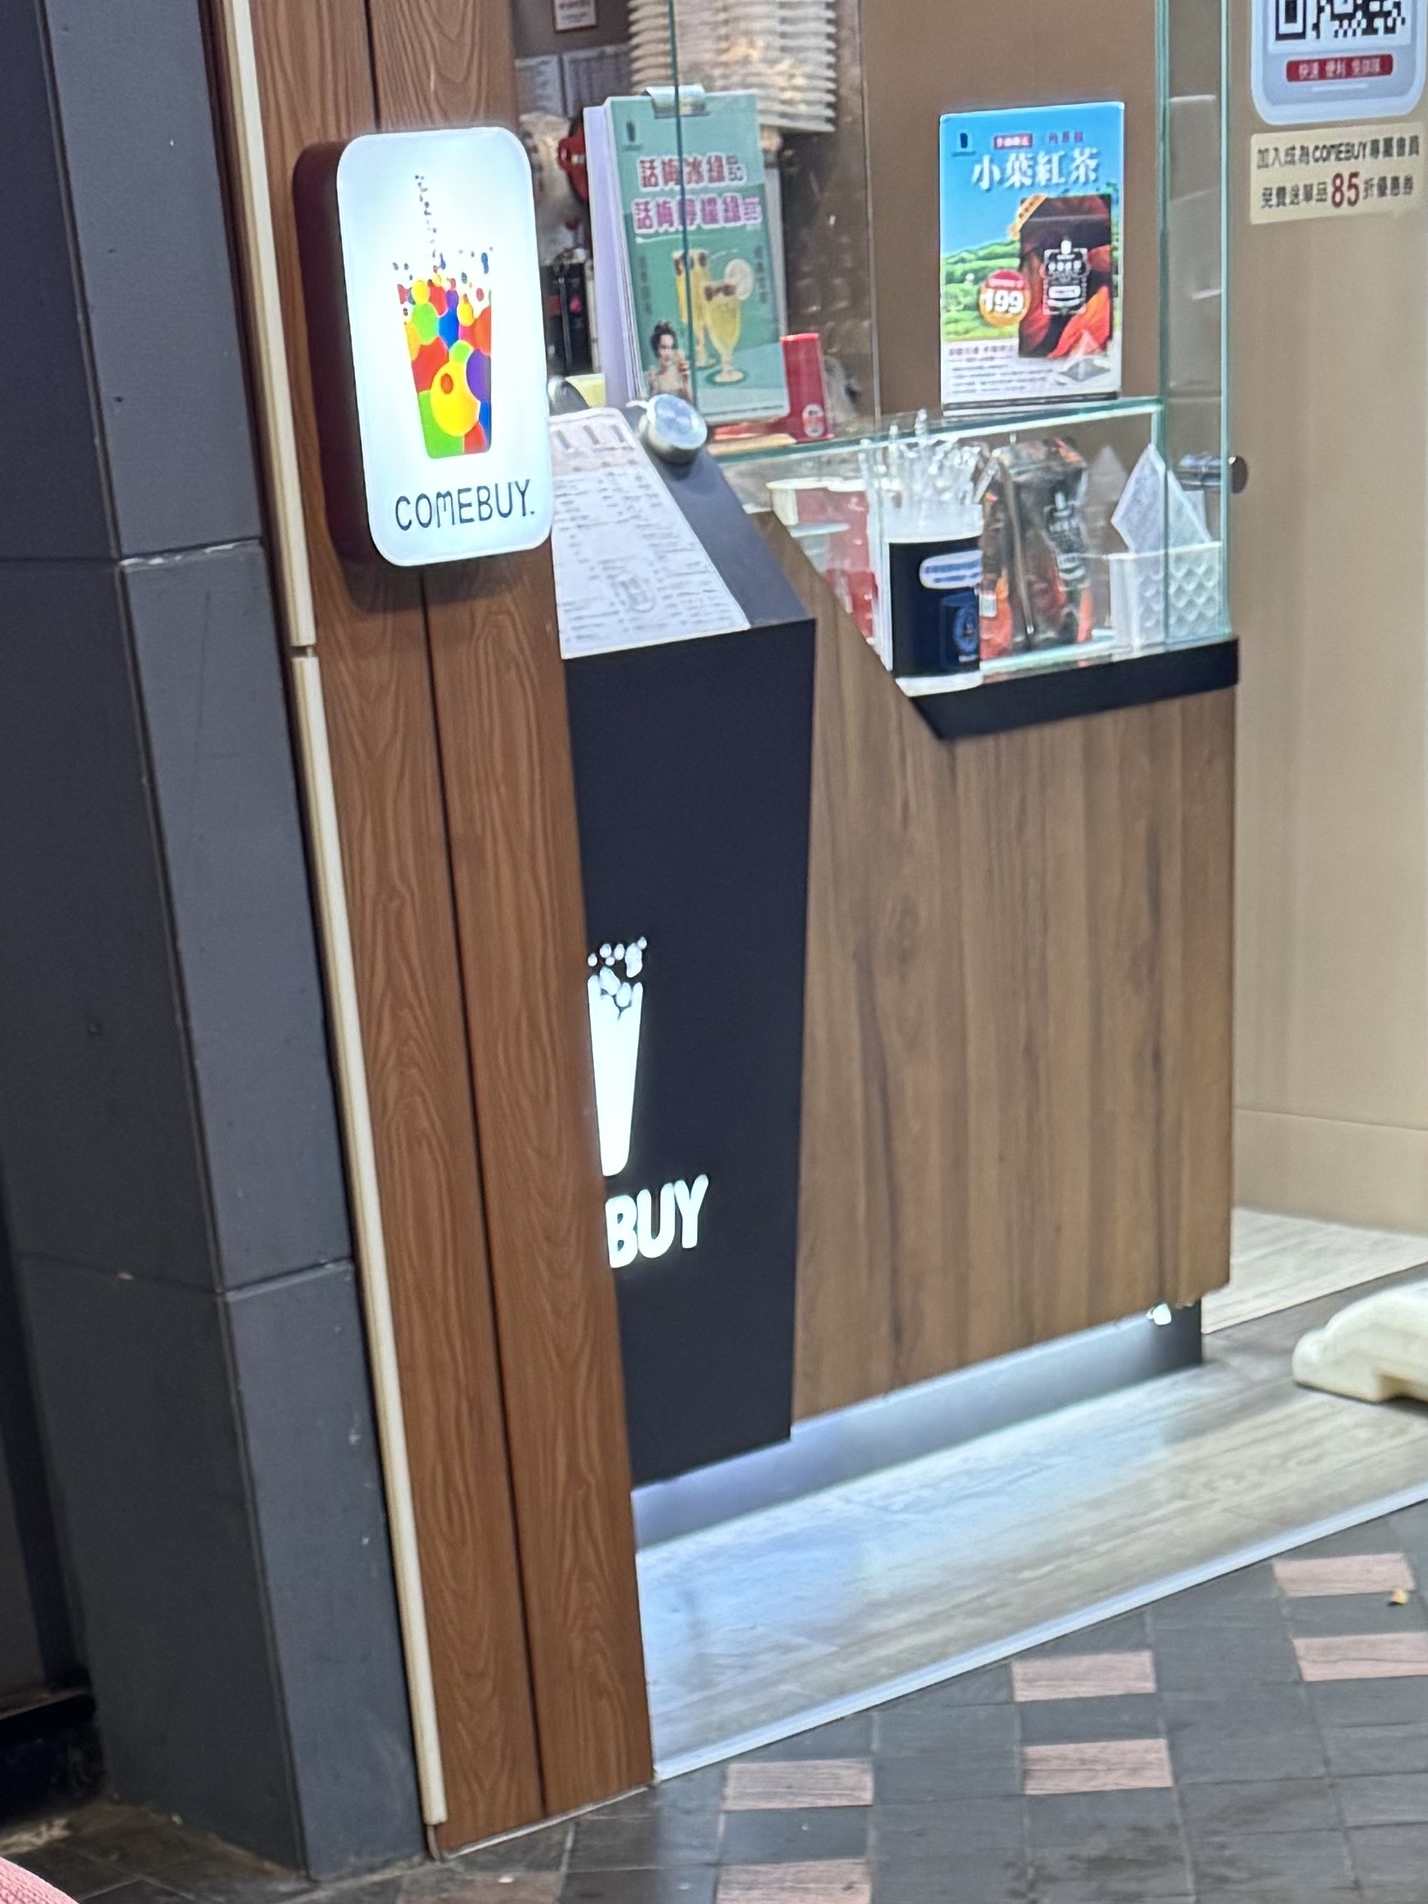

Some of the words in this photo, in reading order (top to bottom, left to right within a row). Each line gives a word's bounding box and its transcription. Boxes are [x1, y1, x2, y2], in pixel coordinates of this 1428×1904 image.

[972, 147, 1100, 190] 小葉紅茶
[981, 288, 1025, 315] 199
